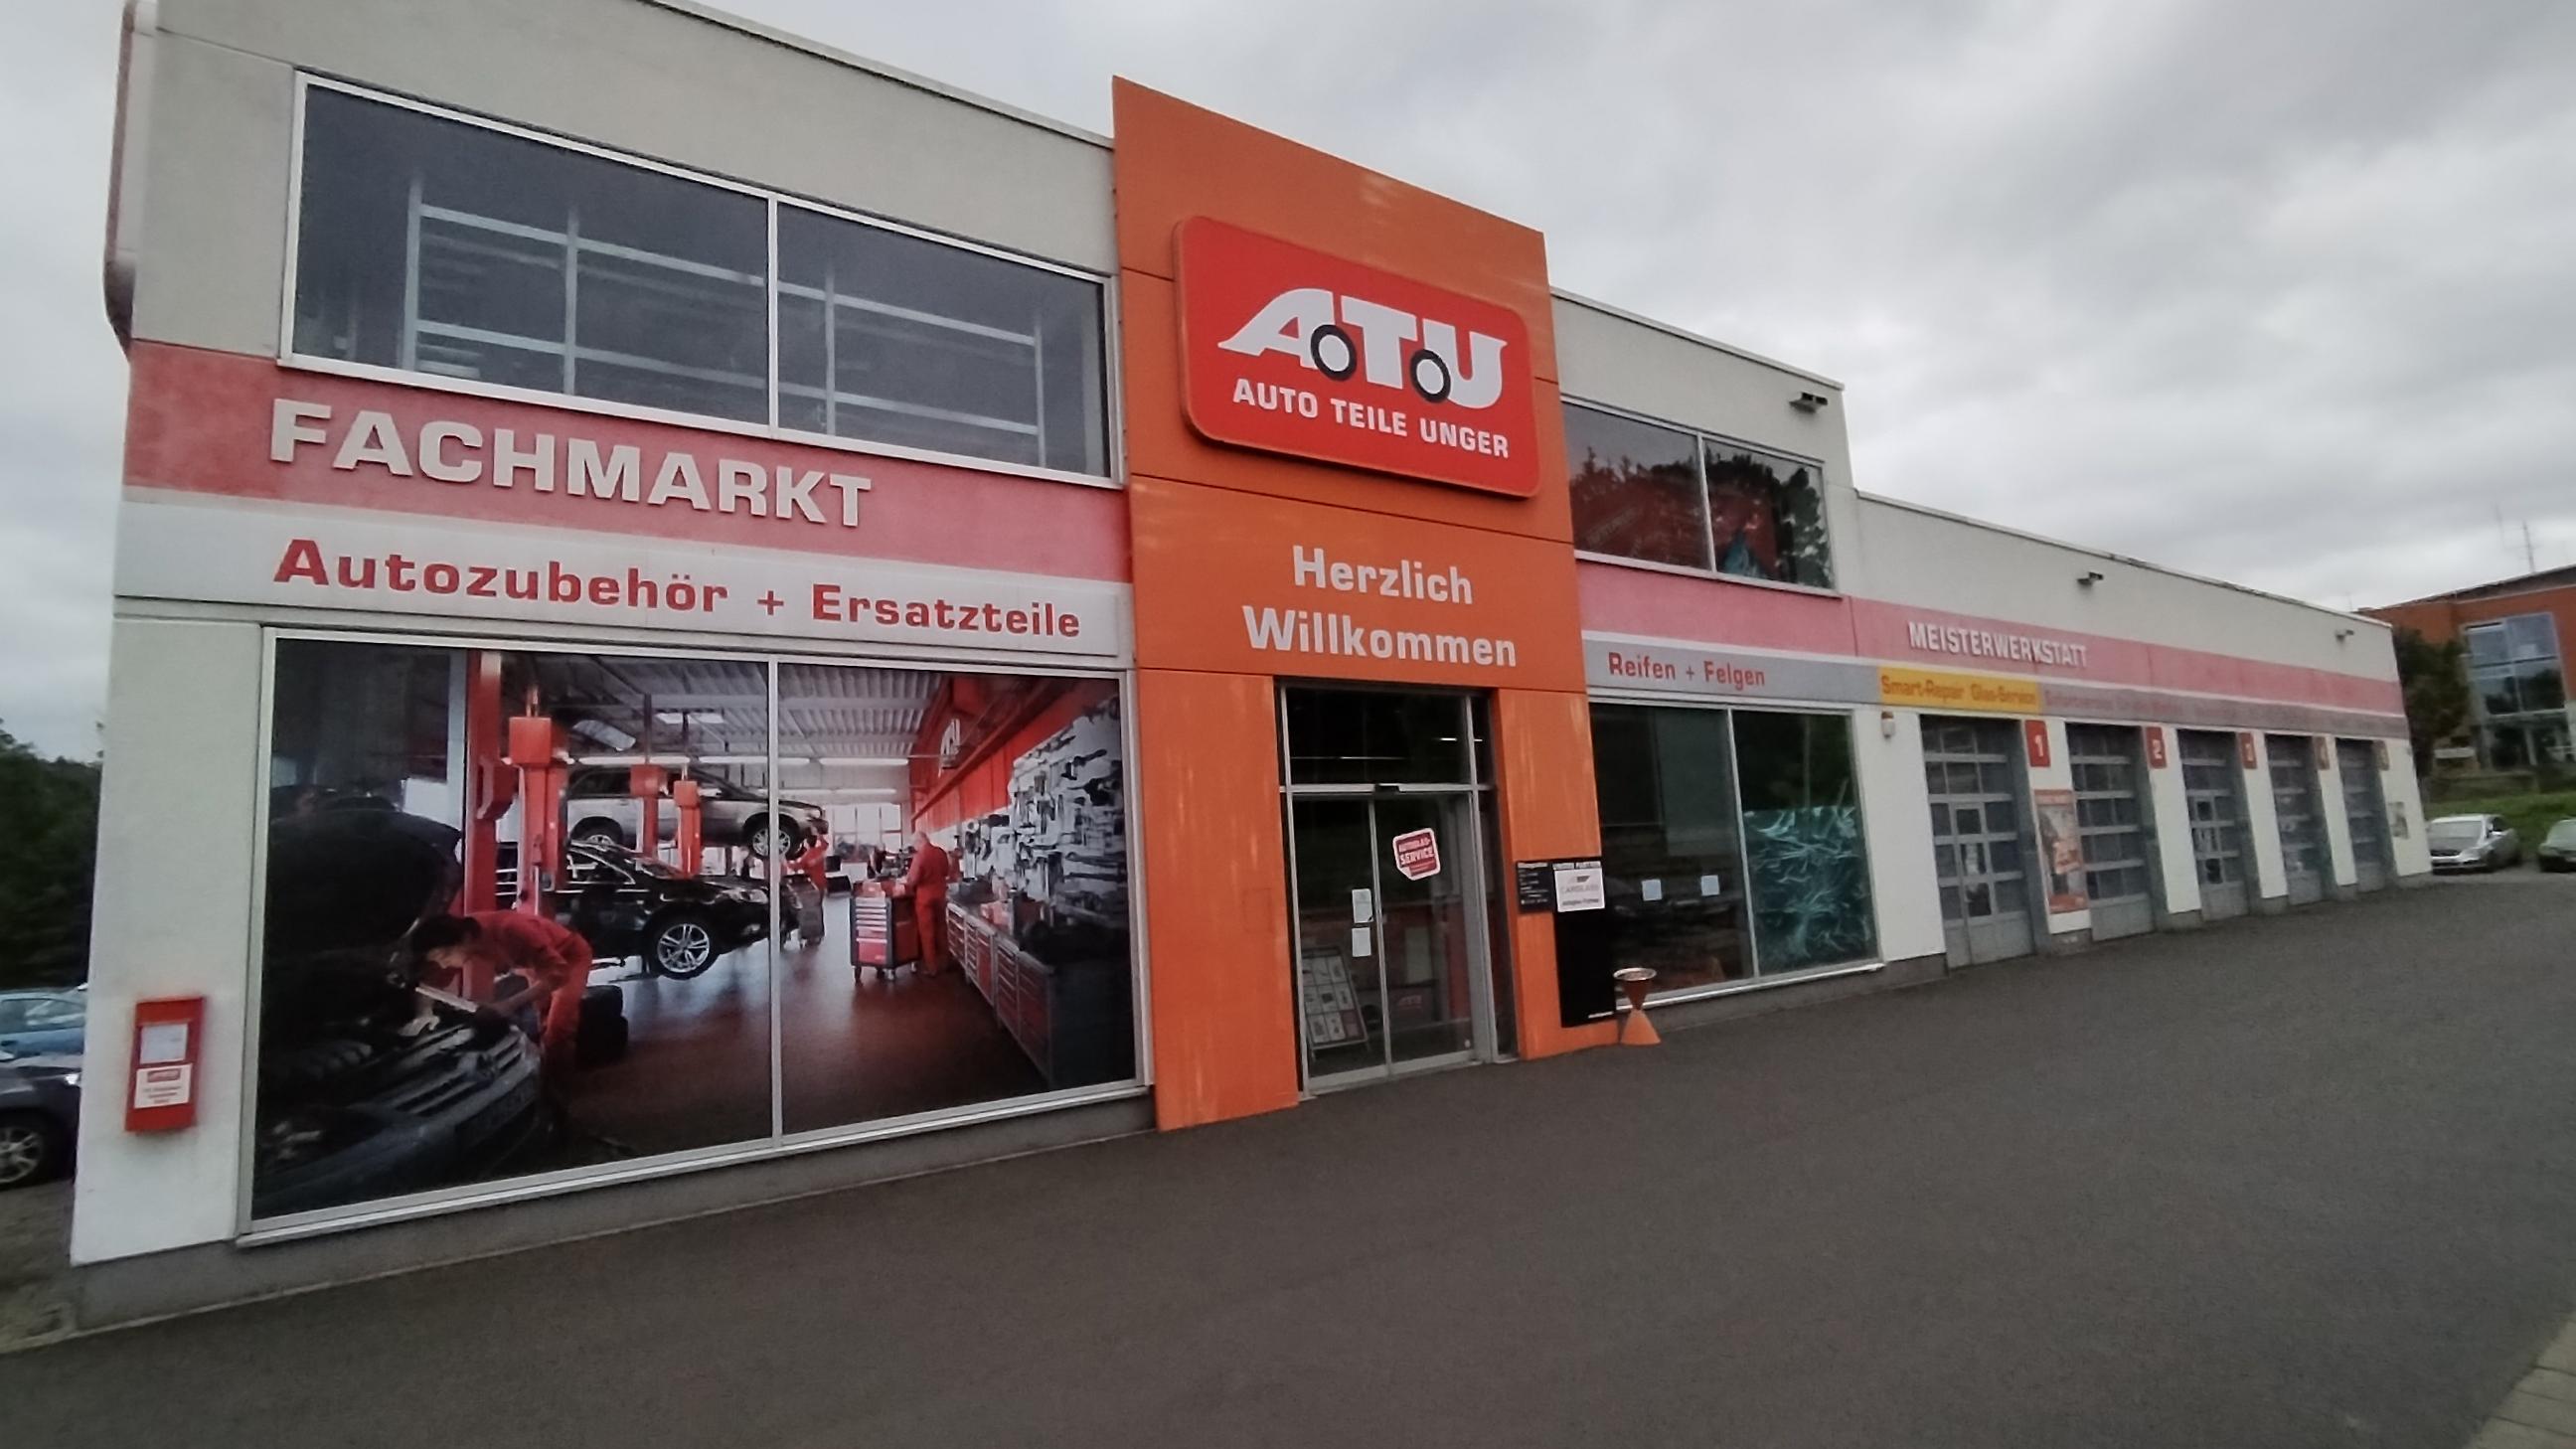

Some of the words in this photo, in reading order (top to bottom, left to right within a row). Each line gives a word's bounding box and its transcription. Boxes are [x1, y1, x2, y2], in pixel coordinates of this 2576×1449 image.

[1232, 377, 1319, 418] AUTO
[1330, 398, 1408, 437] TEILE
[1419, 417, 1510, 459] UNGER
[270, 398, 873, 528] FACHMARKT
[272, 539, 729, 613] Autozubehör
[756, 589, 785, 616] +
[812, 582, 1080, 638] Ersatzteile
[1292, 544, 1474, 605] Herzlich
[1241, 604, 1517, 668] Willkommen
[1907, 620, 2088, 668] MEISTERWERKSTATT
[1608, 651, 1677, 681] Reifen
[1685, 665, 1695, 681] +
[1702, 660, 1766, 691] Felgen
[2033, 733, 2044, 757] 1
[2151, 738, 2164, 759] 2
[1399, 845, 1435, 866] SERVICE
